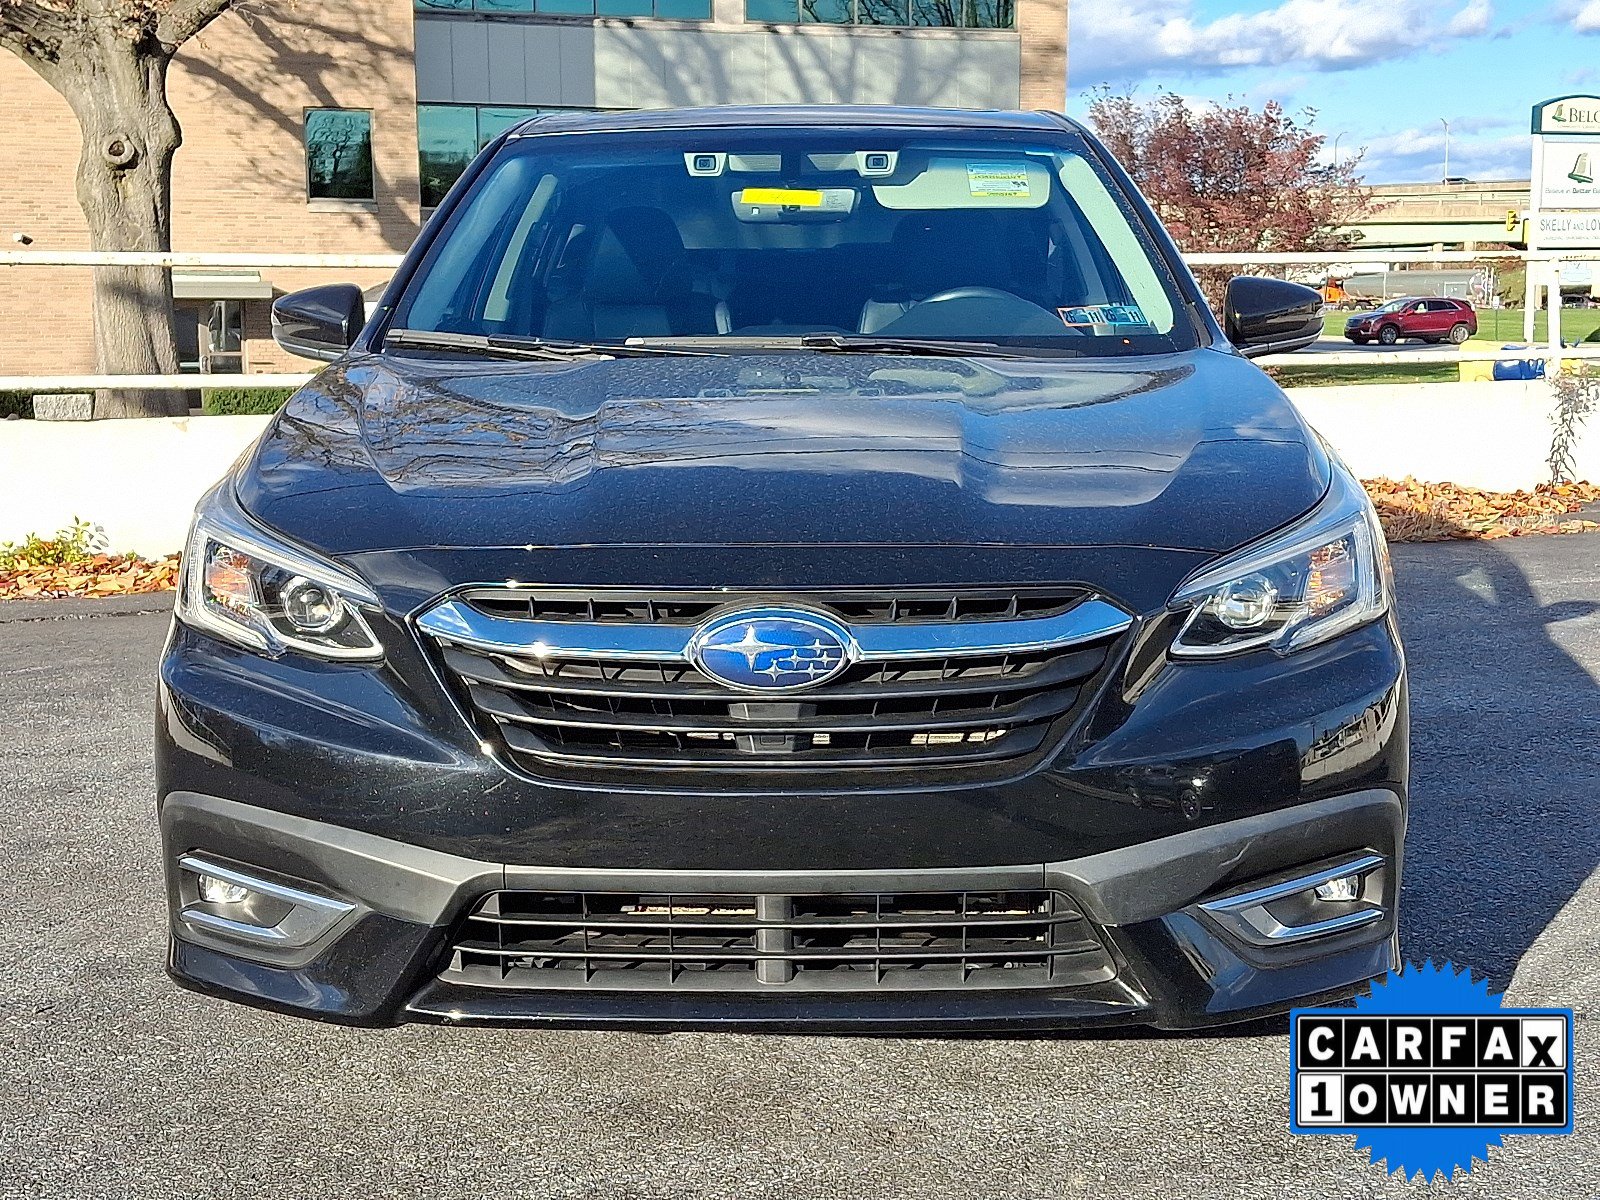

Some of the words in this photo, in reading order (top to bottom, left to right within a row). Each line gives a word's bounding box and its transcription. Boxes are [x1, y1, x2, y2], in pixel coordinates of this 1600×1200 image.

[1540, 219, 1571, 231] SKELLY
[1572, 222, 1585, 231] AND
[1088, 311, 1102, 323] 11
[1128, 311, 1142, 323] 11
